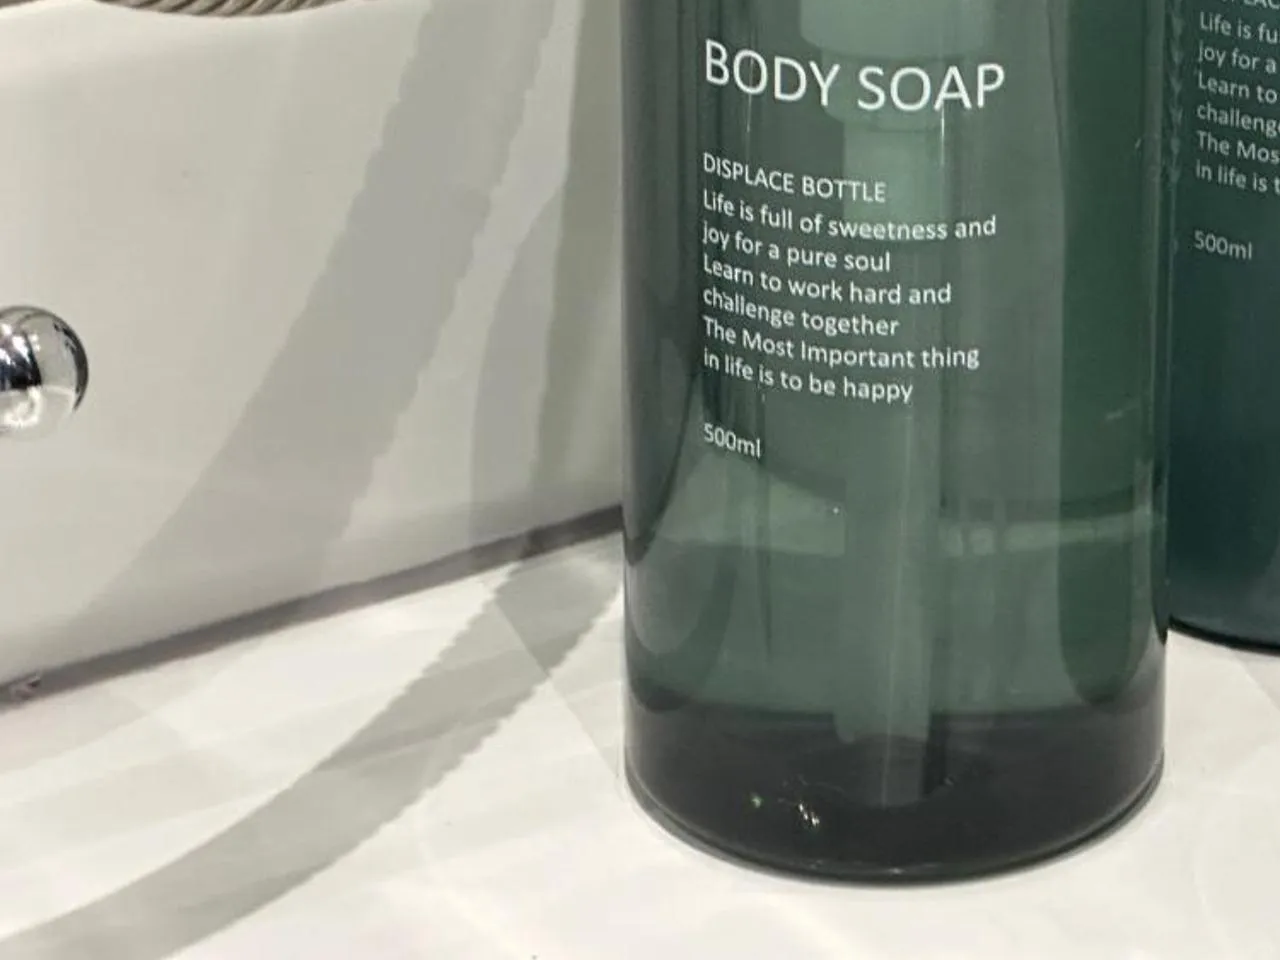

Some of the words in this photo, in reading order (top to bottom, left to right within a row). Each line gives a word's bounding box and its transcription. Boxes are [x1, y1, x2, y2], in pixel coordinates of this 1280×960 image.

[1200, 12, 1232, 37] Life
[1237, 19, 1252, 39] is
[704, 39, 840, 107] BODY
[858, 63, 1005, 111] SOAP
[1198, 41, 1226, 69] joy
[1232, 48, 1259, 70] for
[1265, 58, 1276, 73] a
[1198, 74, 1249, 101] Learn
[1256, 81, 1278, 105] to
[1196, 130, 1230, 156] The
[703, 152, 795, 193] DISPLACE
[802, 176, 886, 203] BOTTLE
[1196, 160, 1212, 181] in
[1217, 165, 1247, 189] life
[1253, 173, 1268, 193] is
[703, 190, 735, 218] Life
[740, 200, 754, 222] is
[760, 204, 792, 231] full
[800, 214, 823, 235] of
[828, 218, 948, 239] sweetness
[955, 215, 997, 238] and
[702, 221, 730, 251] joy
[735, 228, 763, 254] for
[768, 242, 780, 260] a
[787, 246, 837, 270] pure
[844, 250, 891, 272] soul
[1194, 230, 1253, 260] 500ml
[703, 254, 754, 286] Learn
[760, 268, 782, 292] to
[789, 277, 844, 302] work
[850, 280, 901, 305] hard
[909, 283, 952, 305] and
[703, 287, 795, 328] challenge
[801, 310, 900, 338] together
[704, 316, 737, 345] The
[743, 330, 795, 360] Most
[801, 341, 915, 370] Important
[920, 346, 980, 370] thing
[704, 348, 719, 370] in
[725, 354, 753, 382] life
[759, 366, 774, 387] is
[781, 369, 803, 392] to
[809, 373, 836, 396] be
[843, 378, 914, 404] happy
[704, 422, 762, 458] 500ml
